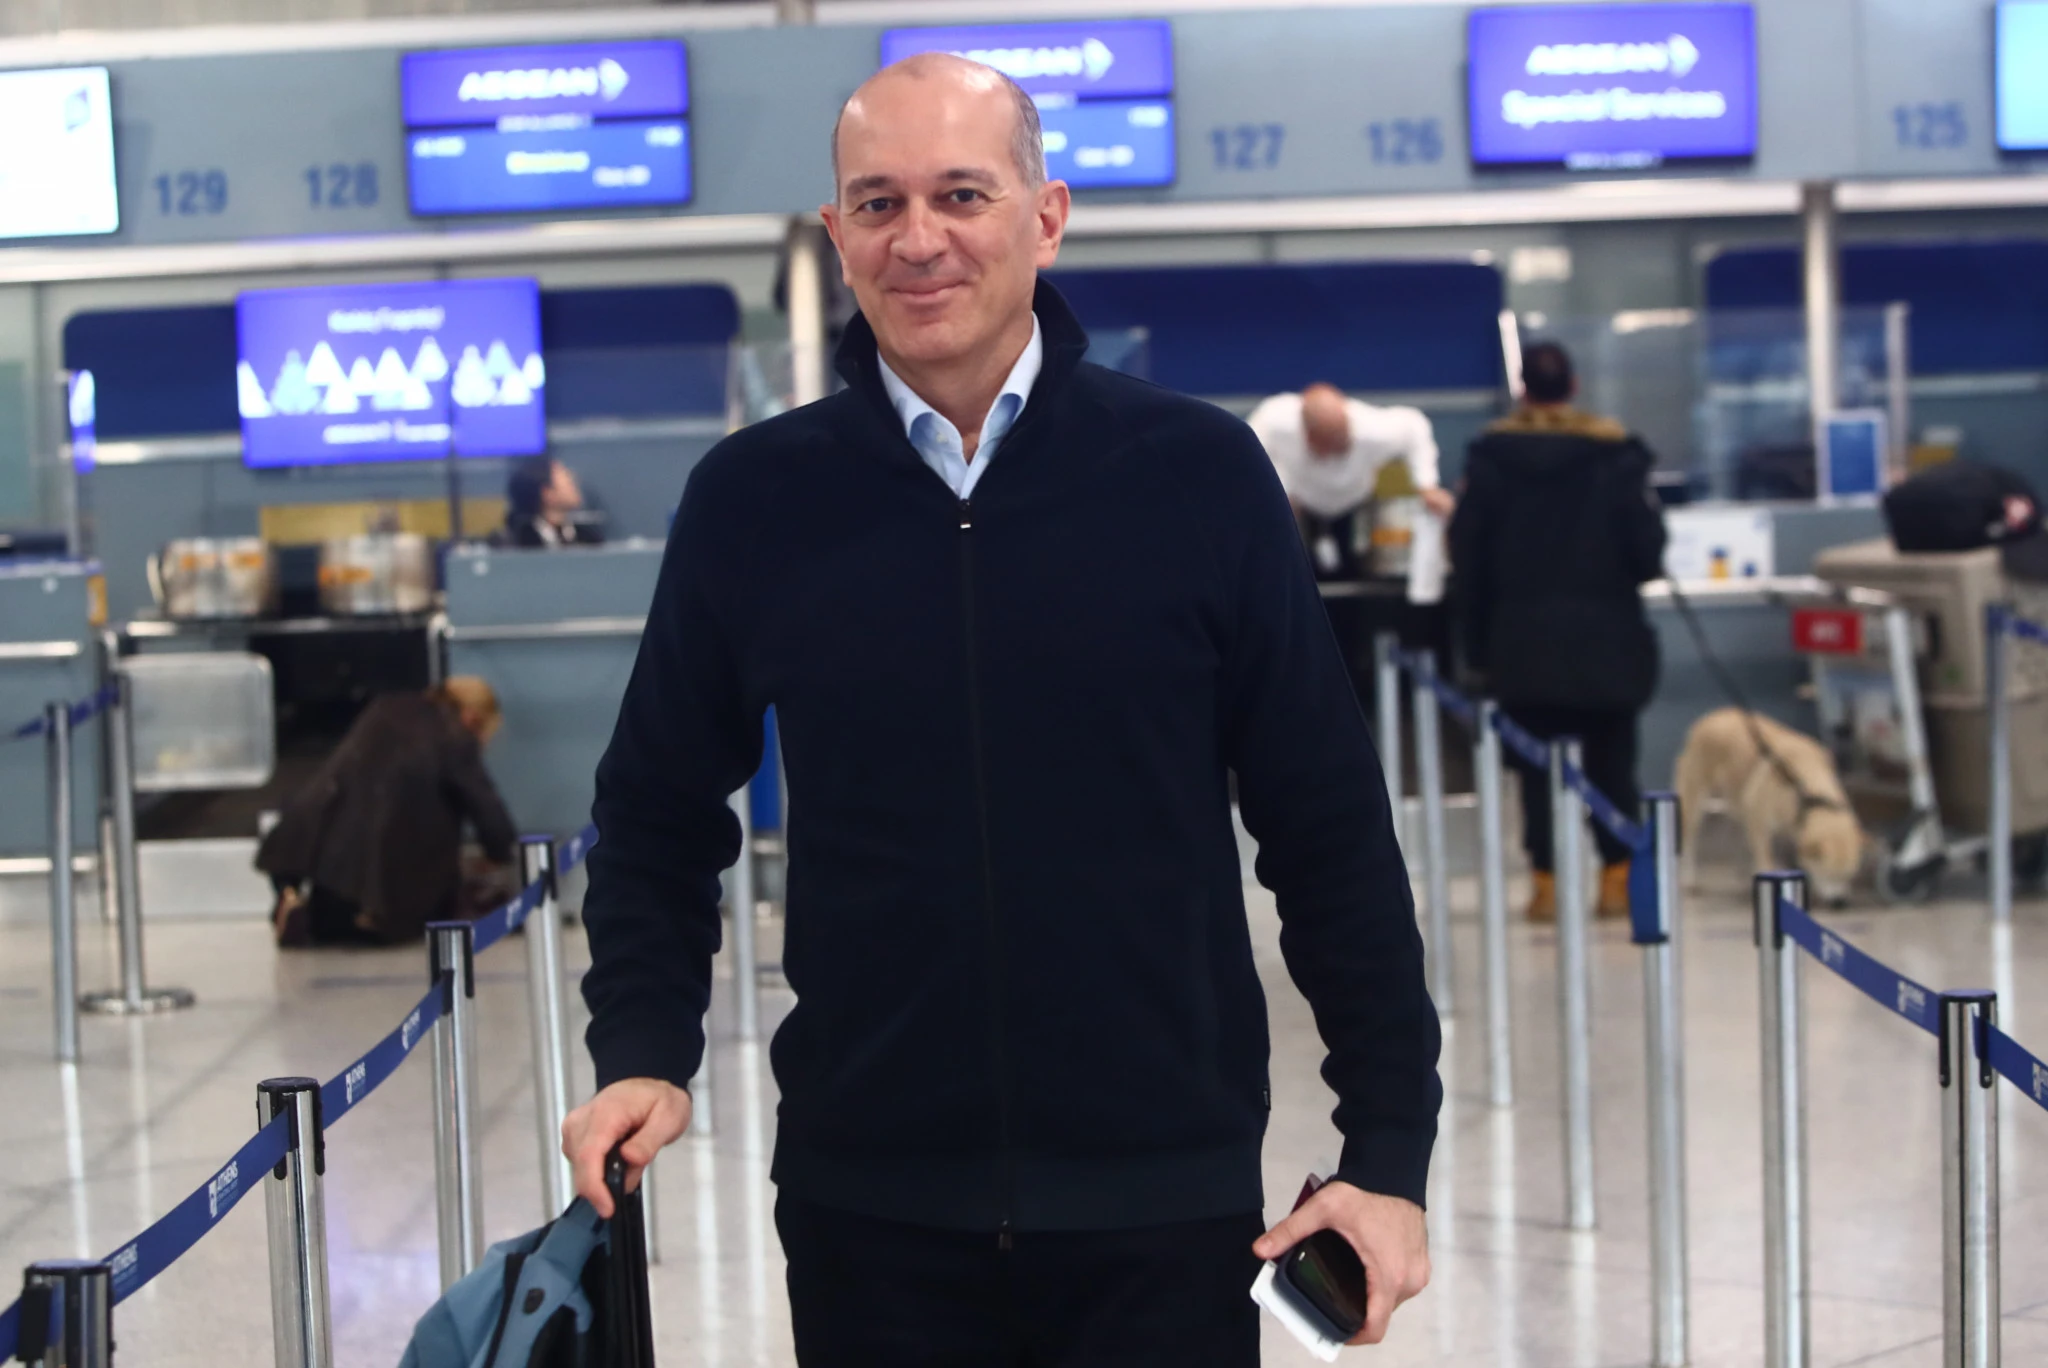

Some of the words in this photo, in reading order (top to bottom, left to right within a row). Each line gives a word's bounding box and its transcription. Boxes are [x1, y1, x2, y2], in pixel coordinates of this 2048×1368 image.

[1526, 43, 1668, 75] AEGEAN
[458, 67, 598, 101] AEGEAN
[1502, 90, 1608, 129] Special
[1609, 87, 1726, 121] Services
[1893, 102, 1967, 148] 125
[1211, 124, 1284, 168] 127
[1368, 118, 1442, 164] 126
[154, 169, 227, 215] 129
[304, 163, 379, 208] 128
[217, 1160, 239, 1190] ATHENS
